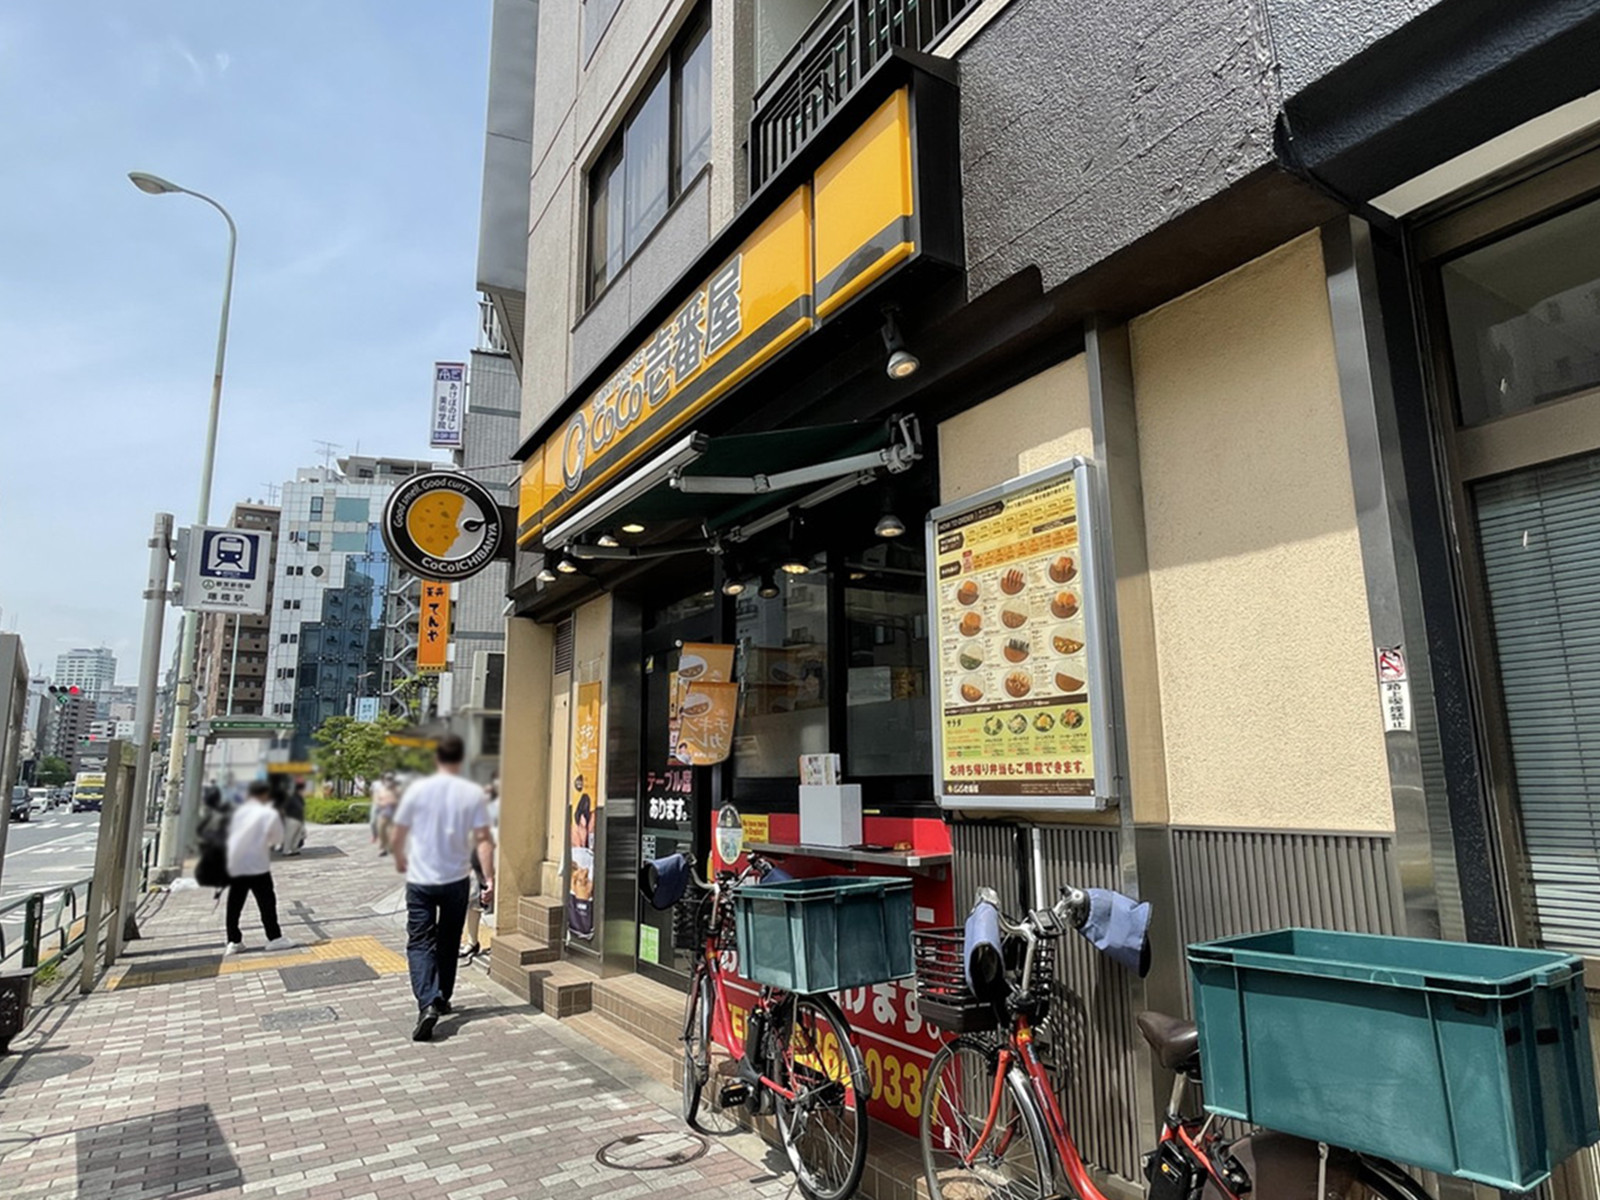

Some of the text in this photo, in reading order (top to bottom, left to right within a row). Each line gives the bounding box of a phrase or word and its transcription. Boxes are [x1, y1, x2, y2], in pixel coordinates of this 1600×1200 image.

[393, 504, 406, 528] Good
[421, 477, 447, 490] Good
[447, 479, 471, 494] curry
[427, 603, 440, 642] てんや
[647, 770, 693, 793] テーブル席
[649, 797, 688, 821] あります。
